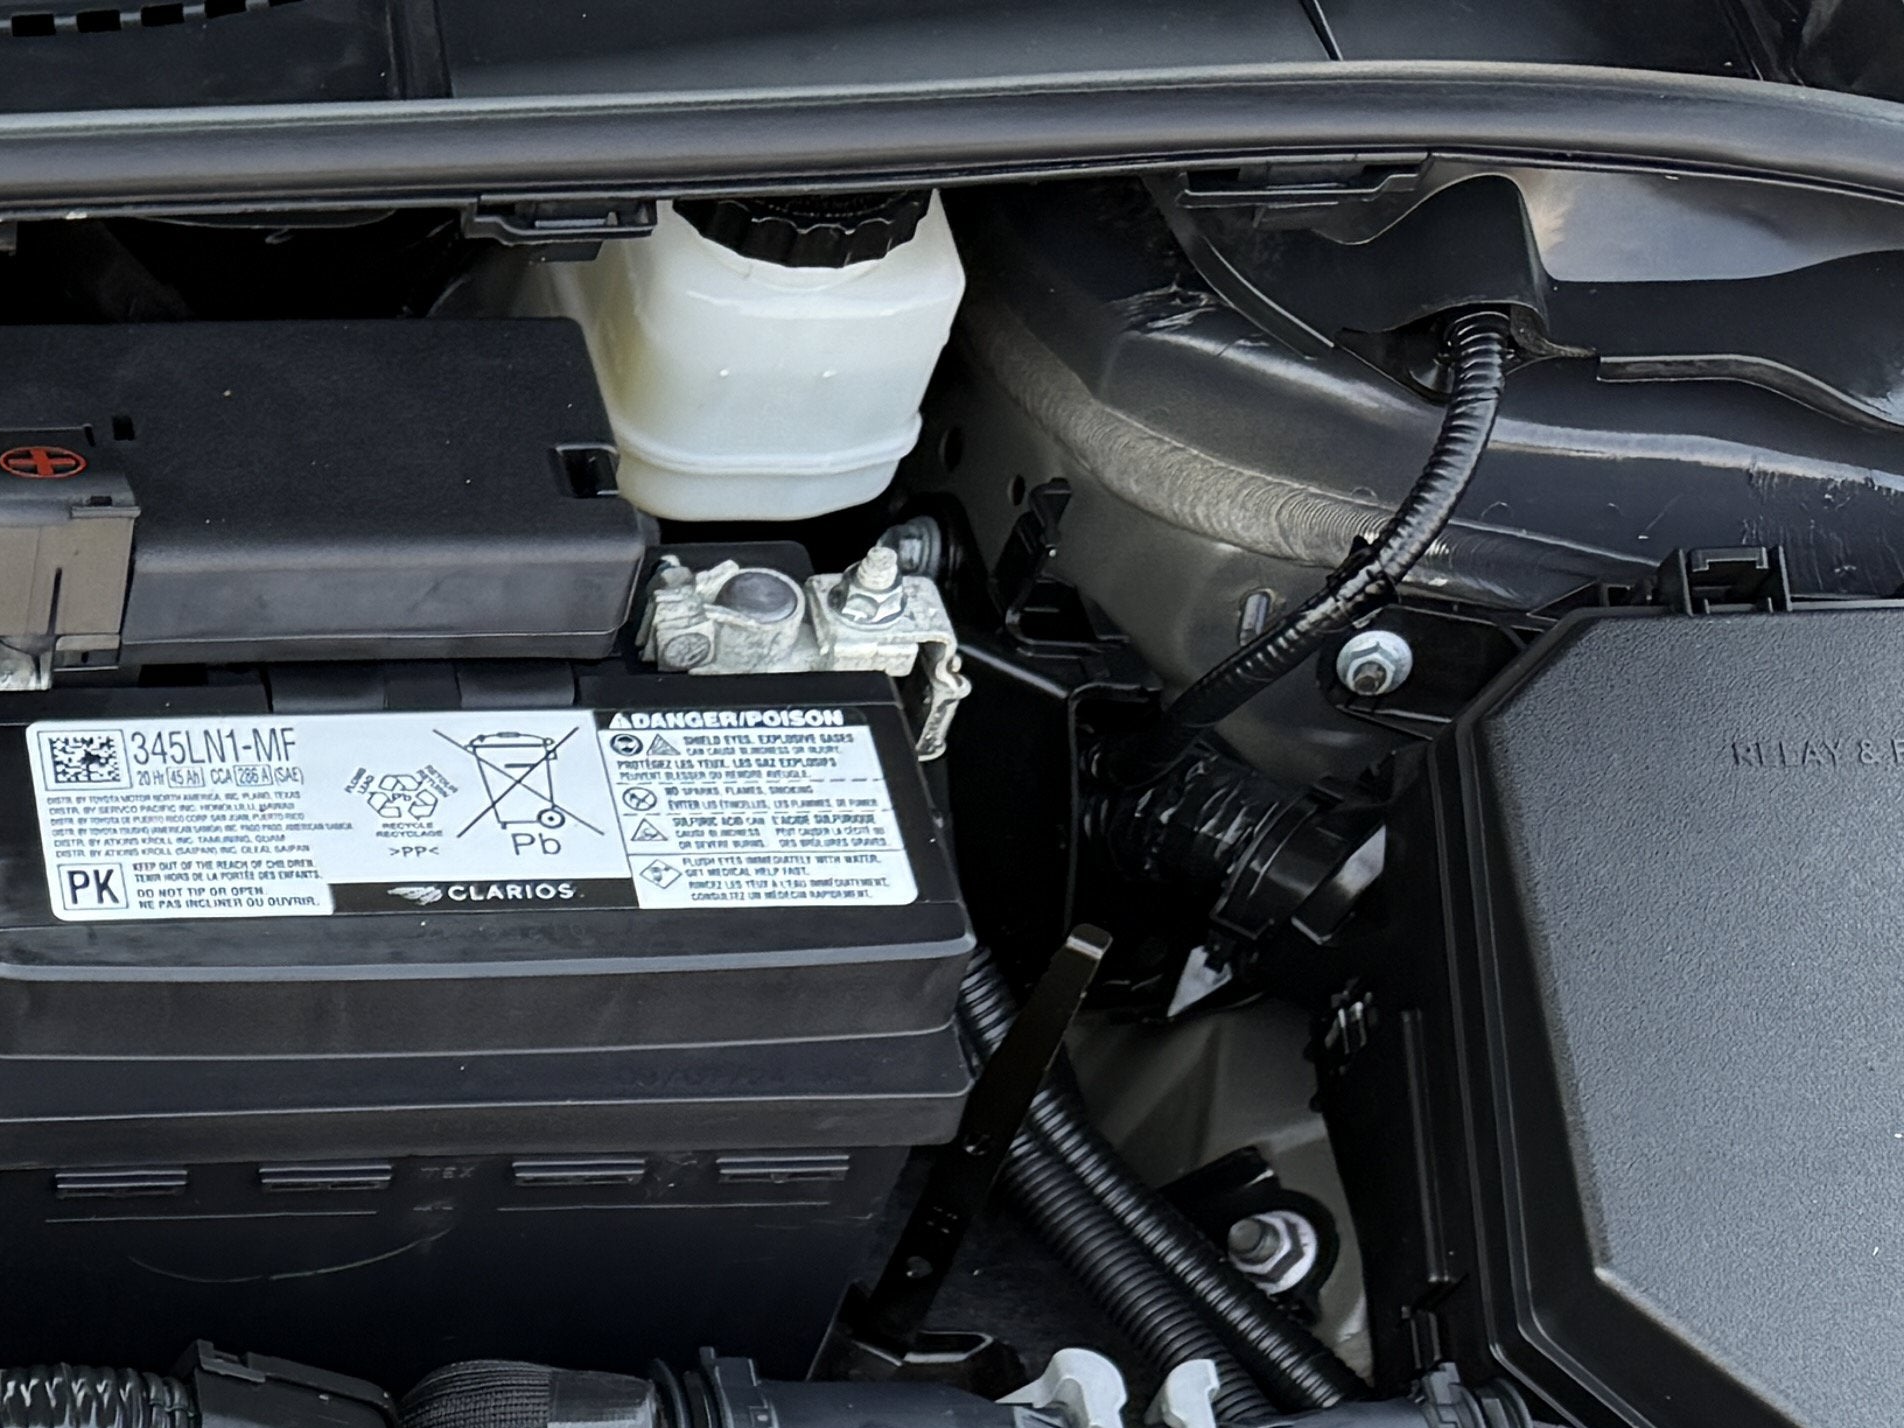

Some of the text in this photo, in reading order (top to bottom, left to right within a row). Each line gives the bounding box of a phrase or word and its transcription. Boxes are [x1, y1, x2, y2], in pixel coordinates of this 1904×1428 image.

[630, 709, 843, 729] DANGER/POISON
[131, 727, 295, 764] 345LN1-MF
[210, 769, 232, 785] CCA
[511, 833, 561, 856] Pb
[67, 868, 120, 905] PK
[138, 888, 154, 898] DO
[159, 888, 183, 897] NOT
[448, 883, 574, 901] CLARIOS
[159, 900, 182, 909] PAS
